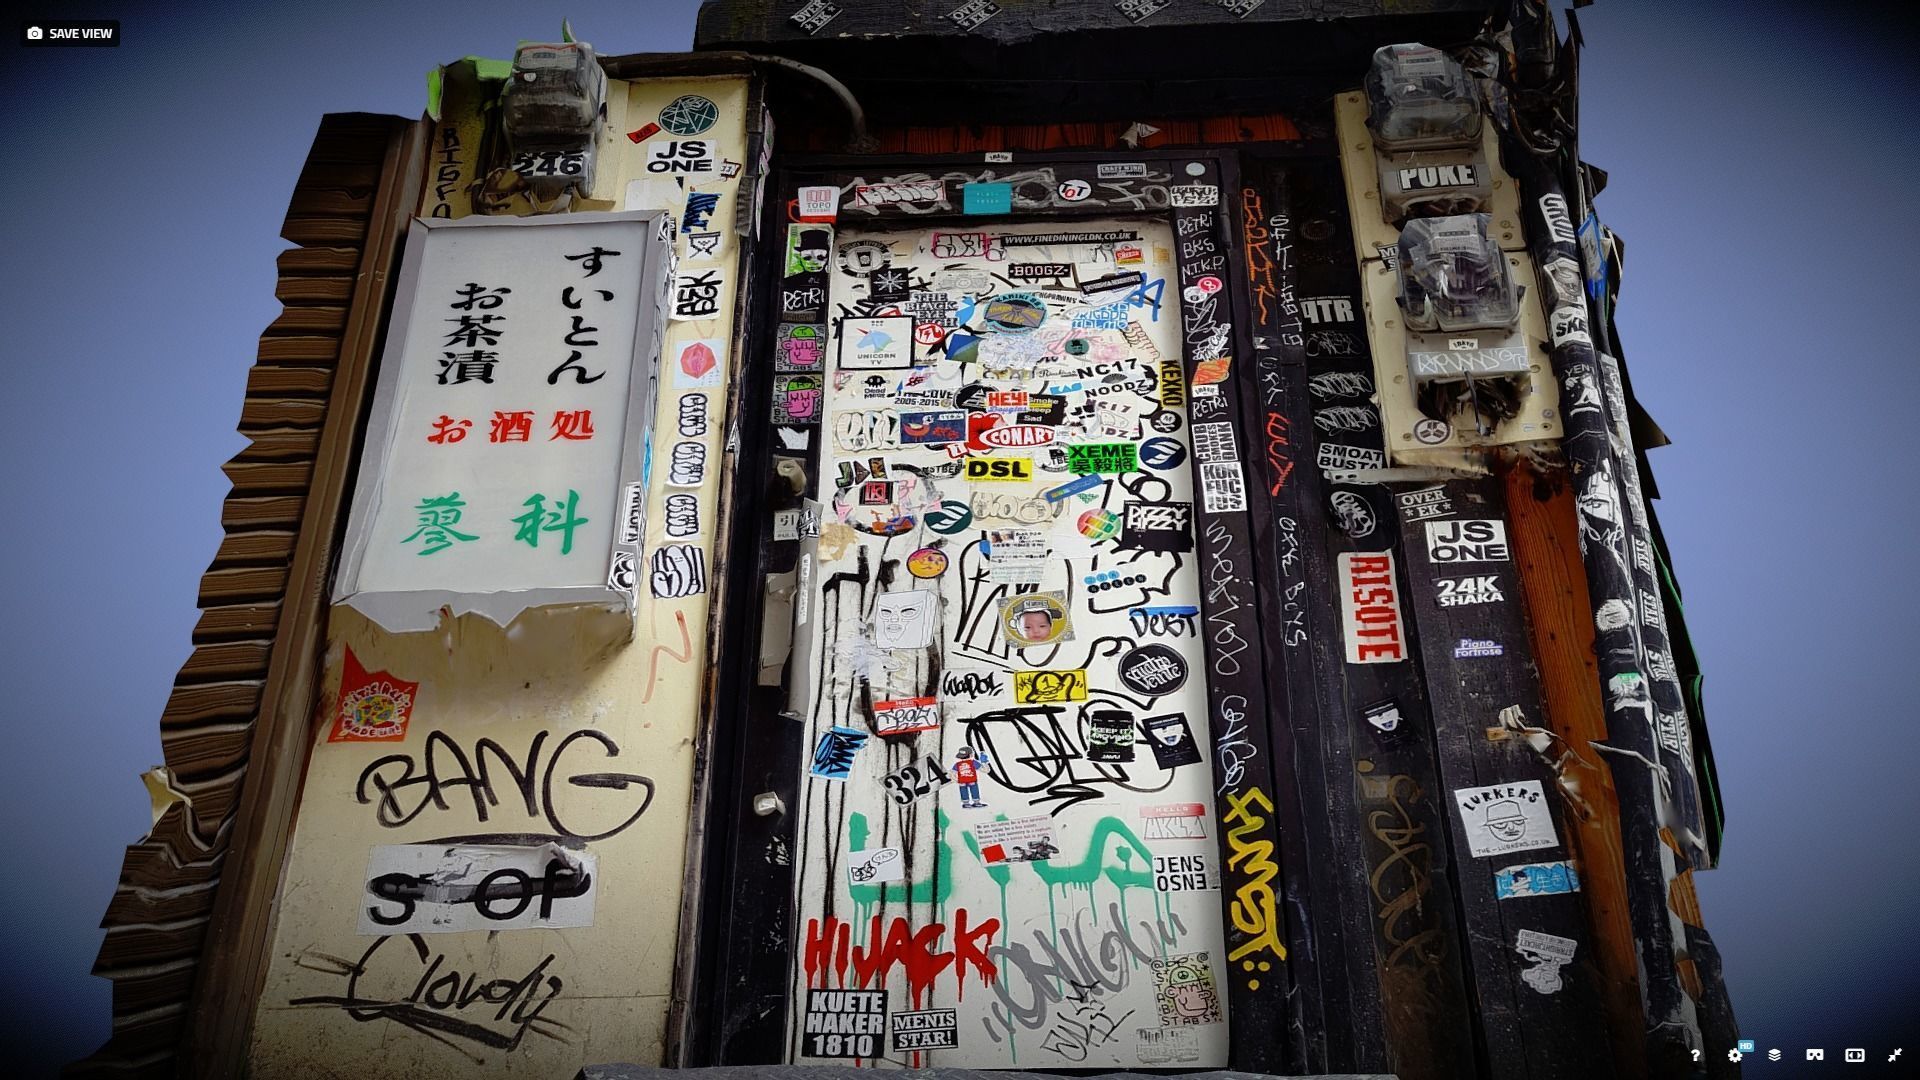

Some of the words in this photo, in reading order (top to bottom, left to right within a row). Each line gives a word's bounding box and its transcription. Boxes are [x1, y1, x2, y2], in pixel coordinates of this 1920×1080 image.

[656, 141, 707, 159] JS
[514, 156, 583, 177] 246
[647, 160, 713, 174] ONE
[1399, 164, 1475, 189] PUKE
[547, 246, 622, 385] すいとん
[435, 283, 512, 385] お茶漬
[1077, 358, 1137, 379] NC17
[988, 391, 1028, 407] HEY!
[1084, 380, 1149, 398] NOODZ
[427, 410, 595, 444] お酒処
[990, 426, 1055, 446] CONART
[1070, 444, 1136, 458] XEME
[1320, 443, 1383, 463] SMOAT
[968, 460, 1029, 479] DSL
[1401, 489, 1447, 506] OVER
[400, 489, 589, 556] 蓼科
[1438, 521, 1495, 544] JS
[1430, 543, 1509, 562] ONE
[1437, 575, 1500, 598] 24K
[1350, 556, 1402, 661] RISOTE
[1440, 591, 1504, 607] SHAKA
[1461, 638, 1495, 648] Piano
[356, 730, 655, 841] BANG
[884, 754, 951, 805] 324
[1463, 787, 1540, 812] LURKERS
[1154, 855, 1205, 873] JENS
[368, 858, 591, 926] SOP
[803, 908, 1001, 992] HIJACK
[811, 991, 884, 1013] KUETE
[806, 1012, 884, 1034] HAKER
[893, 1011, 956, 1031] MENIS
[813, 1034, 874, 1057] 1810
[899, 1030, 952, 1049] STAR!
